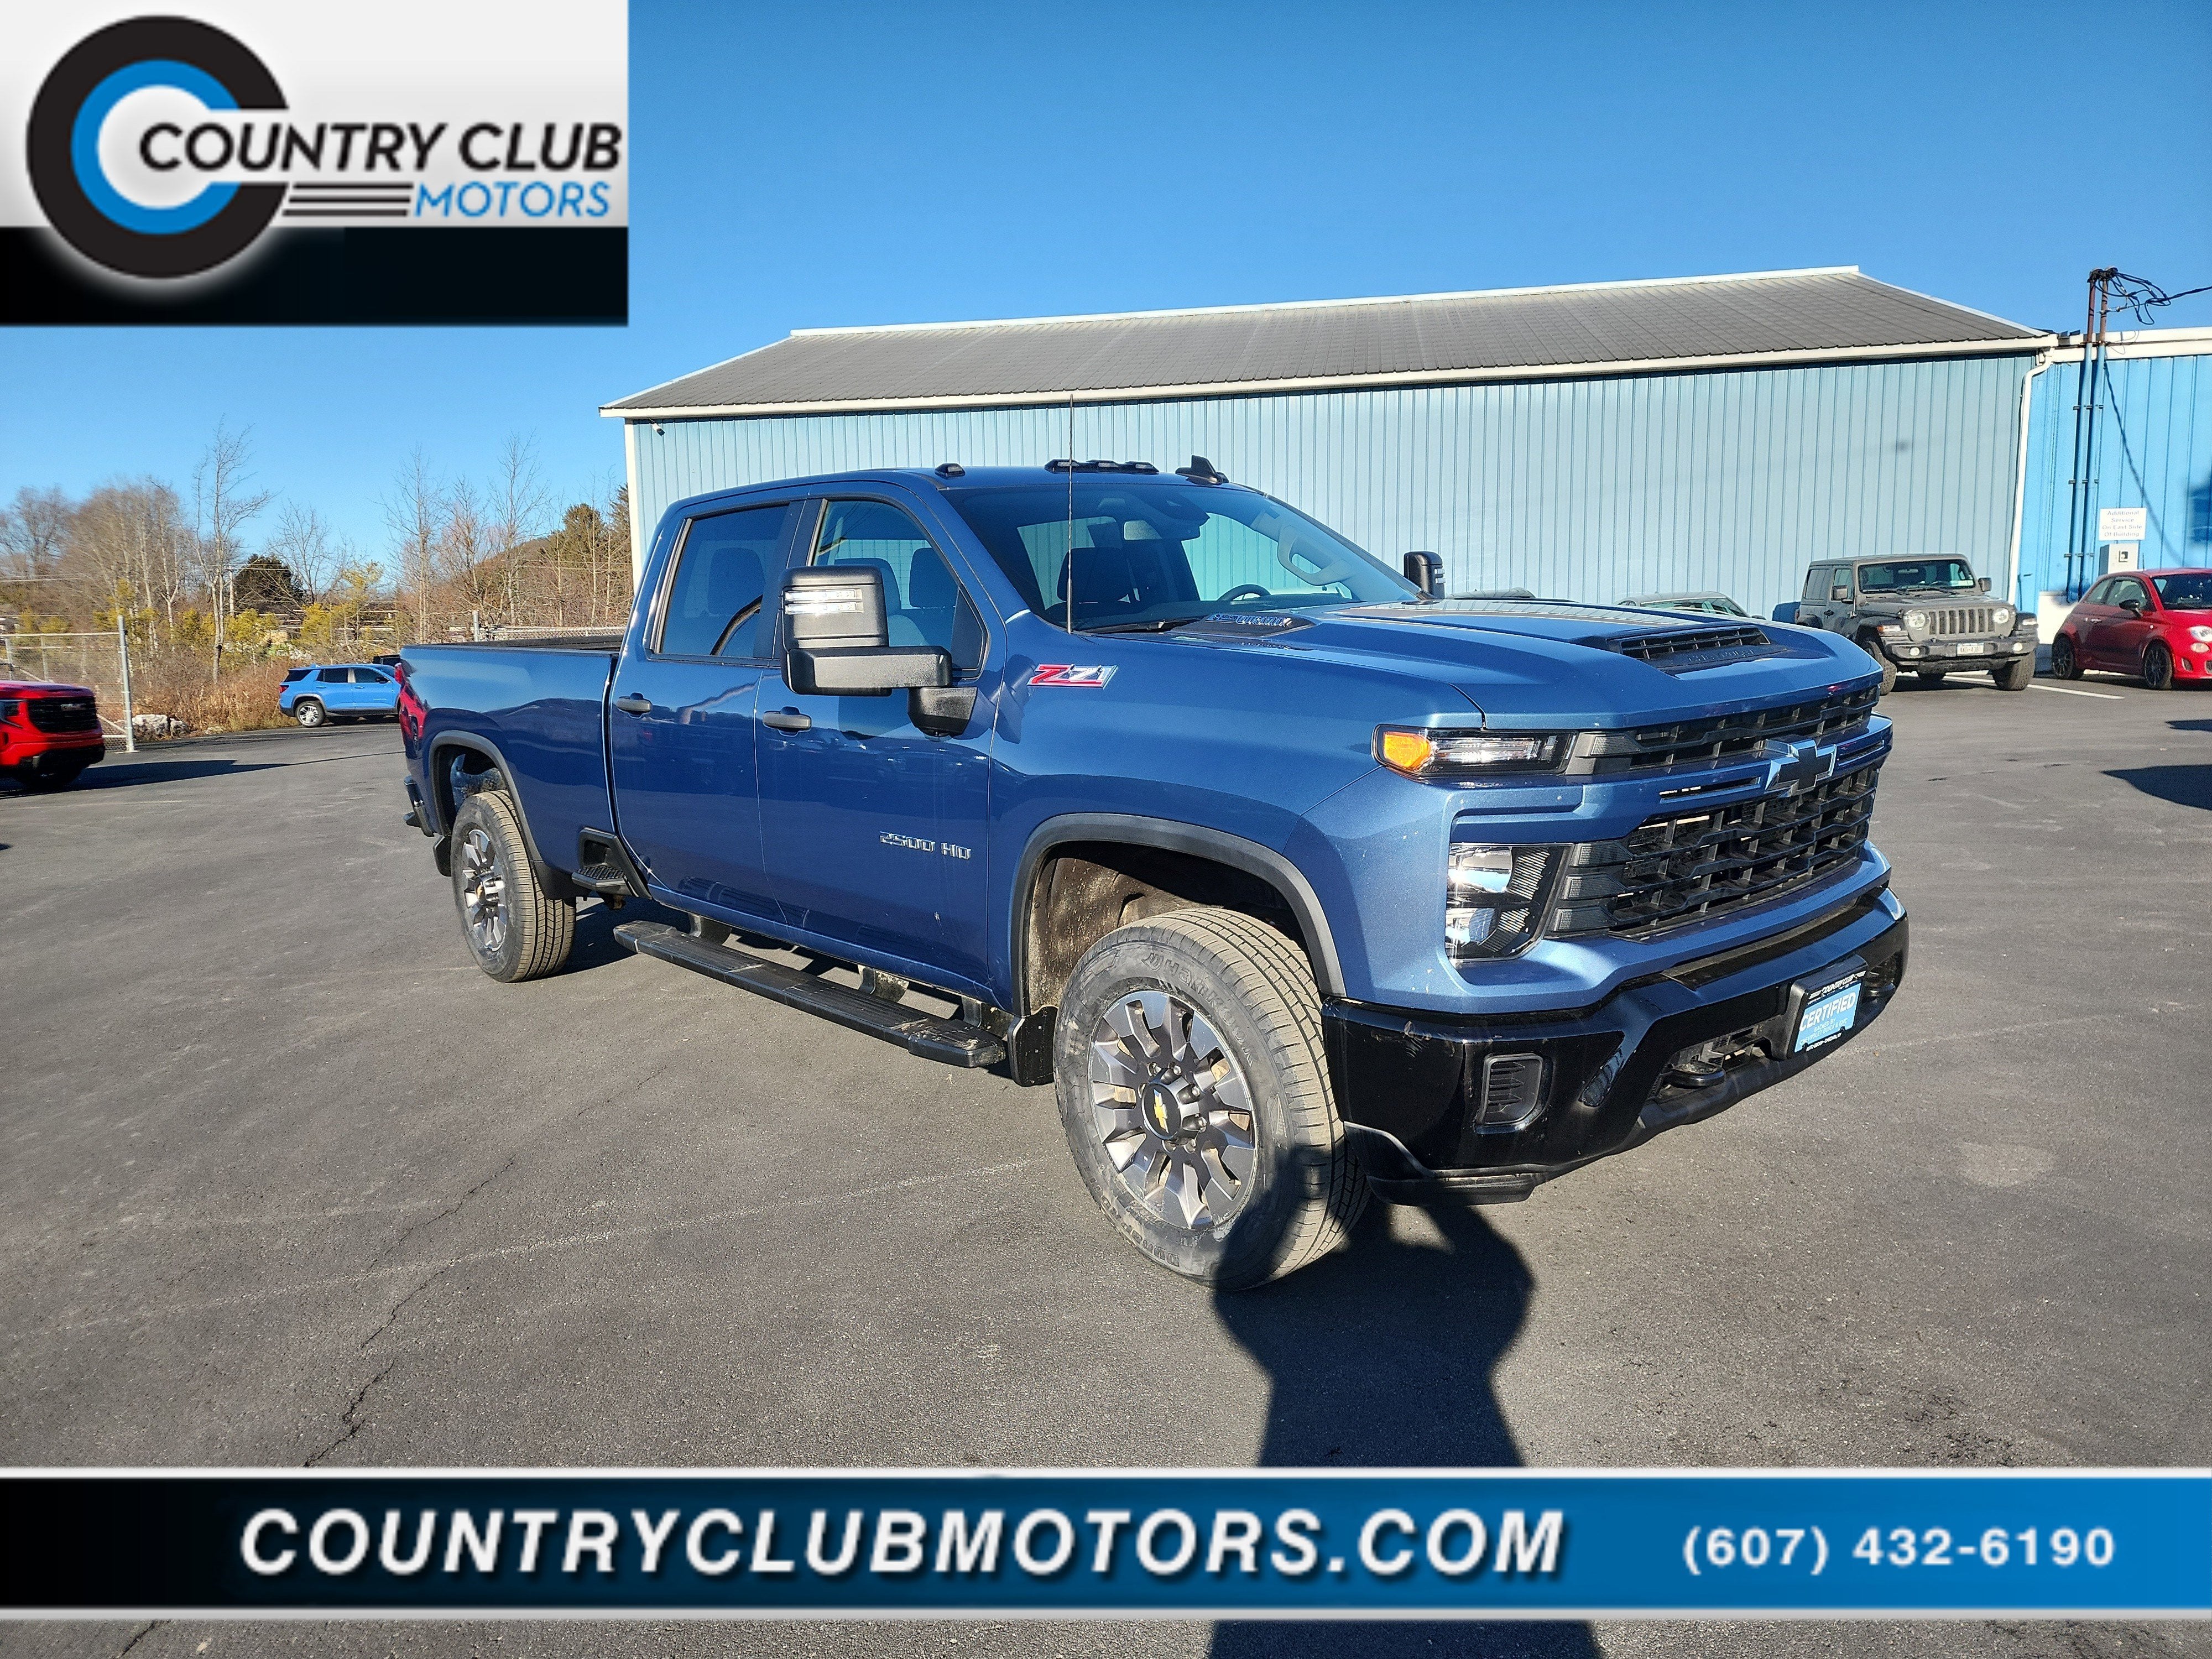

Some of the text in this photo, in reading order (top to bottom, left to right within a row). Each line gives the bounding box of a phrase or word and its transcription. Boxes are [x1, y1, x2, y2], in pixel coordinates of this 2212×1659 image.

[879, 831, 972, 860] 2500 HD
[1799, 992, 1856, 1032] CERTIFIED
